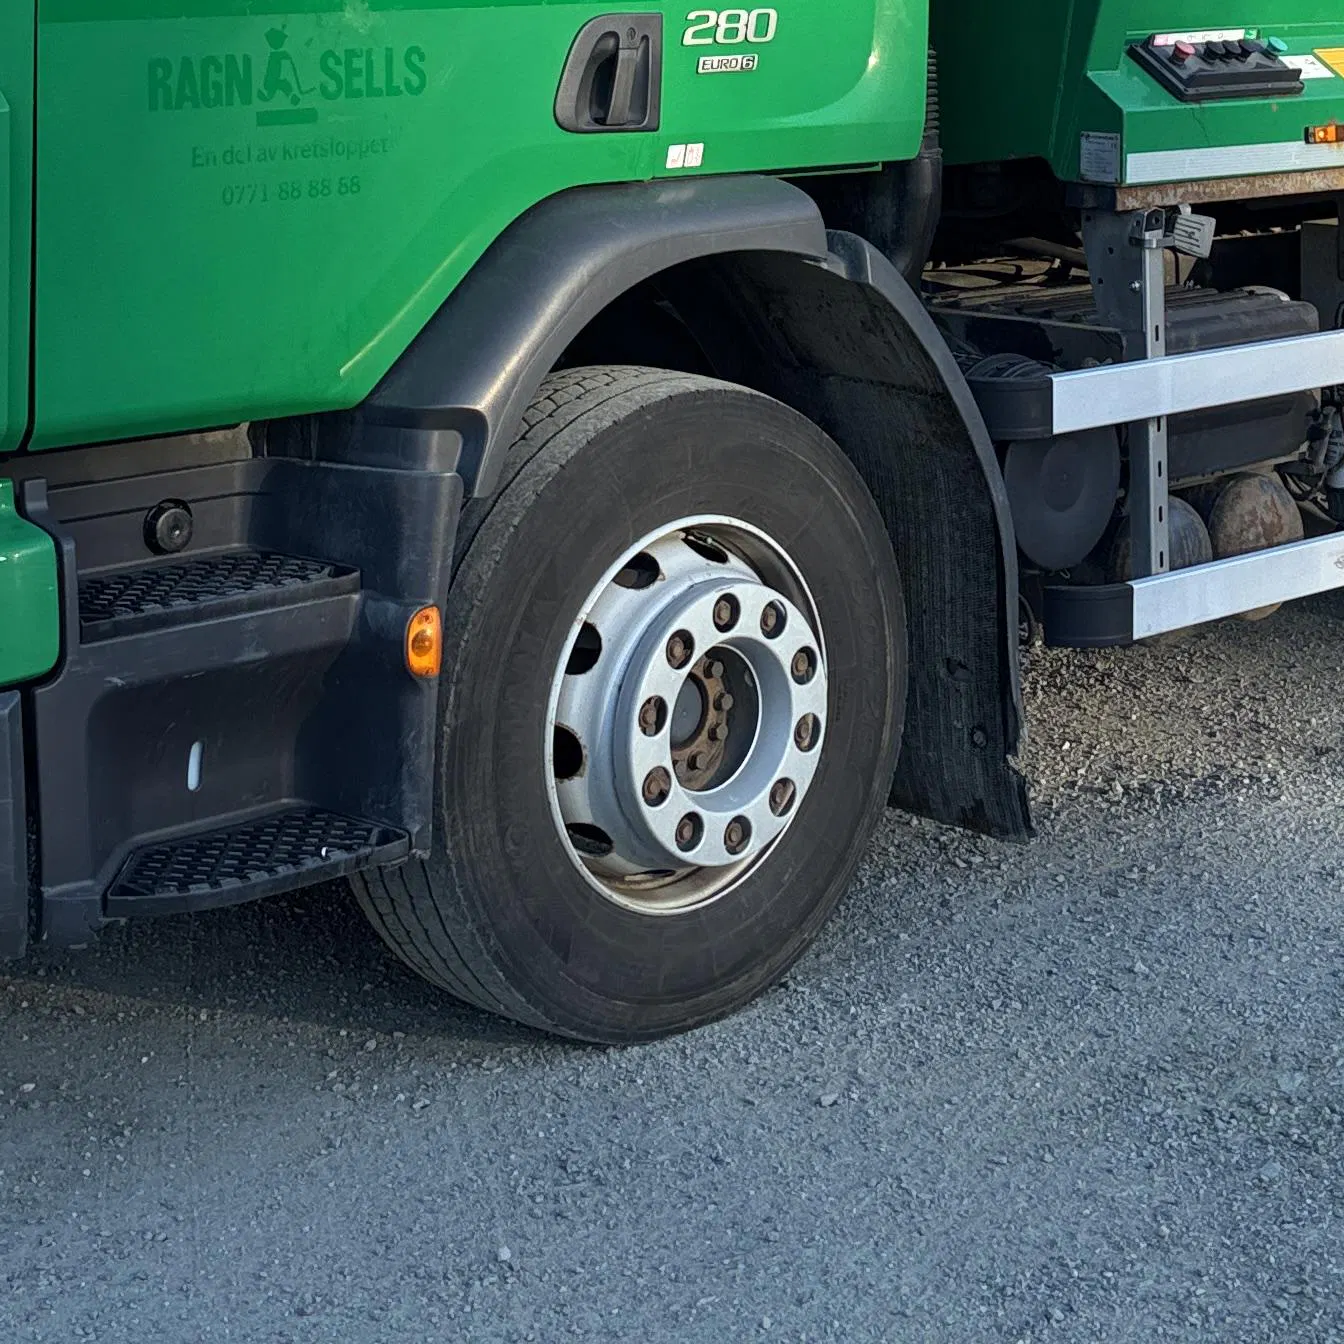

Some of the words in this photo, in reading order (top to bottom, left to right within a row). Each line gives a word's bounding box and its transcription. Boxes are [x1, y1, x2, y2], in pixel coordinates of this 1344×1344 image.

[682, 8, 778, 46] 280
[147, 53, 253, 112] RAGN
[319, 45, 428, 101] SELLS
[701, 57, 739, 71] EURO
[191, 145, 218, 168] En
[256, 149, 278, 163] av
[222, 183, 270, 206] 0771
[278, 181, 302, 202] 88
[308, 178, 333, 199] 88
[337, 175, 362, 196] 88
